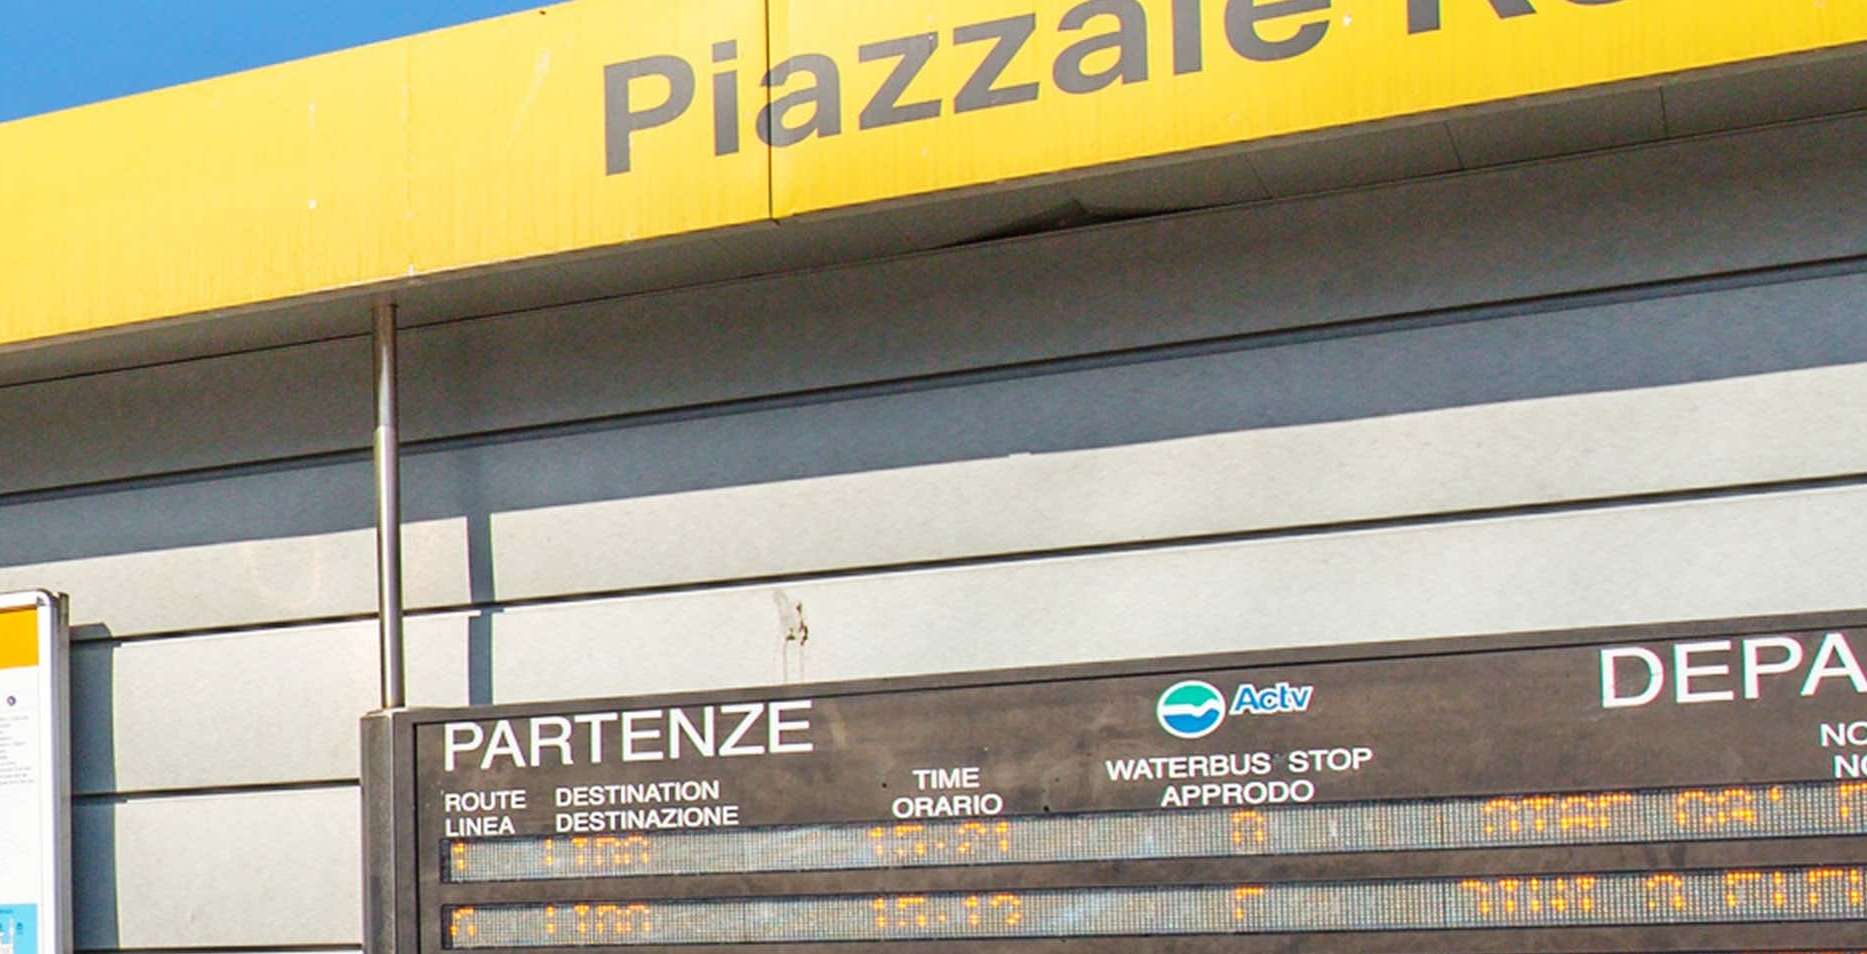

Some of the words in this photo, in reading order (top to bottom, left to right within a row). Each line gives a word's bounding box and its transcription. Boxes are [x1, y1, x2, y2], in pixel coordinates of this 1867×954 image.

[603, 0, 1331, 174] Piazzale
[1600, 632, 1867, 708] DEPA
[1229, 682, 1314, 715] Actv
[443, 699, 814, 772] PARTENZE
[912, 767, 980, 790] TIME
[1105, 751, 1271, 781] WATERBUS
[1288, 747, 1374, 773] STOP
[444, 789, 527, 812] ROUTE
[555, 780, 720, 808] DESTINATION
[891, 794, 1004, 819] ORARIO
[1160, 780, 1315, 807] APPRODO
[445, 816, 516, 837] LINEA
[555, 806, 739, 832] DESTINAZIONE
